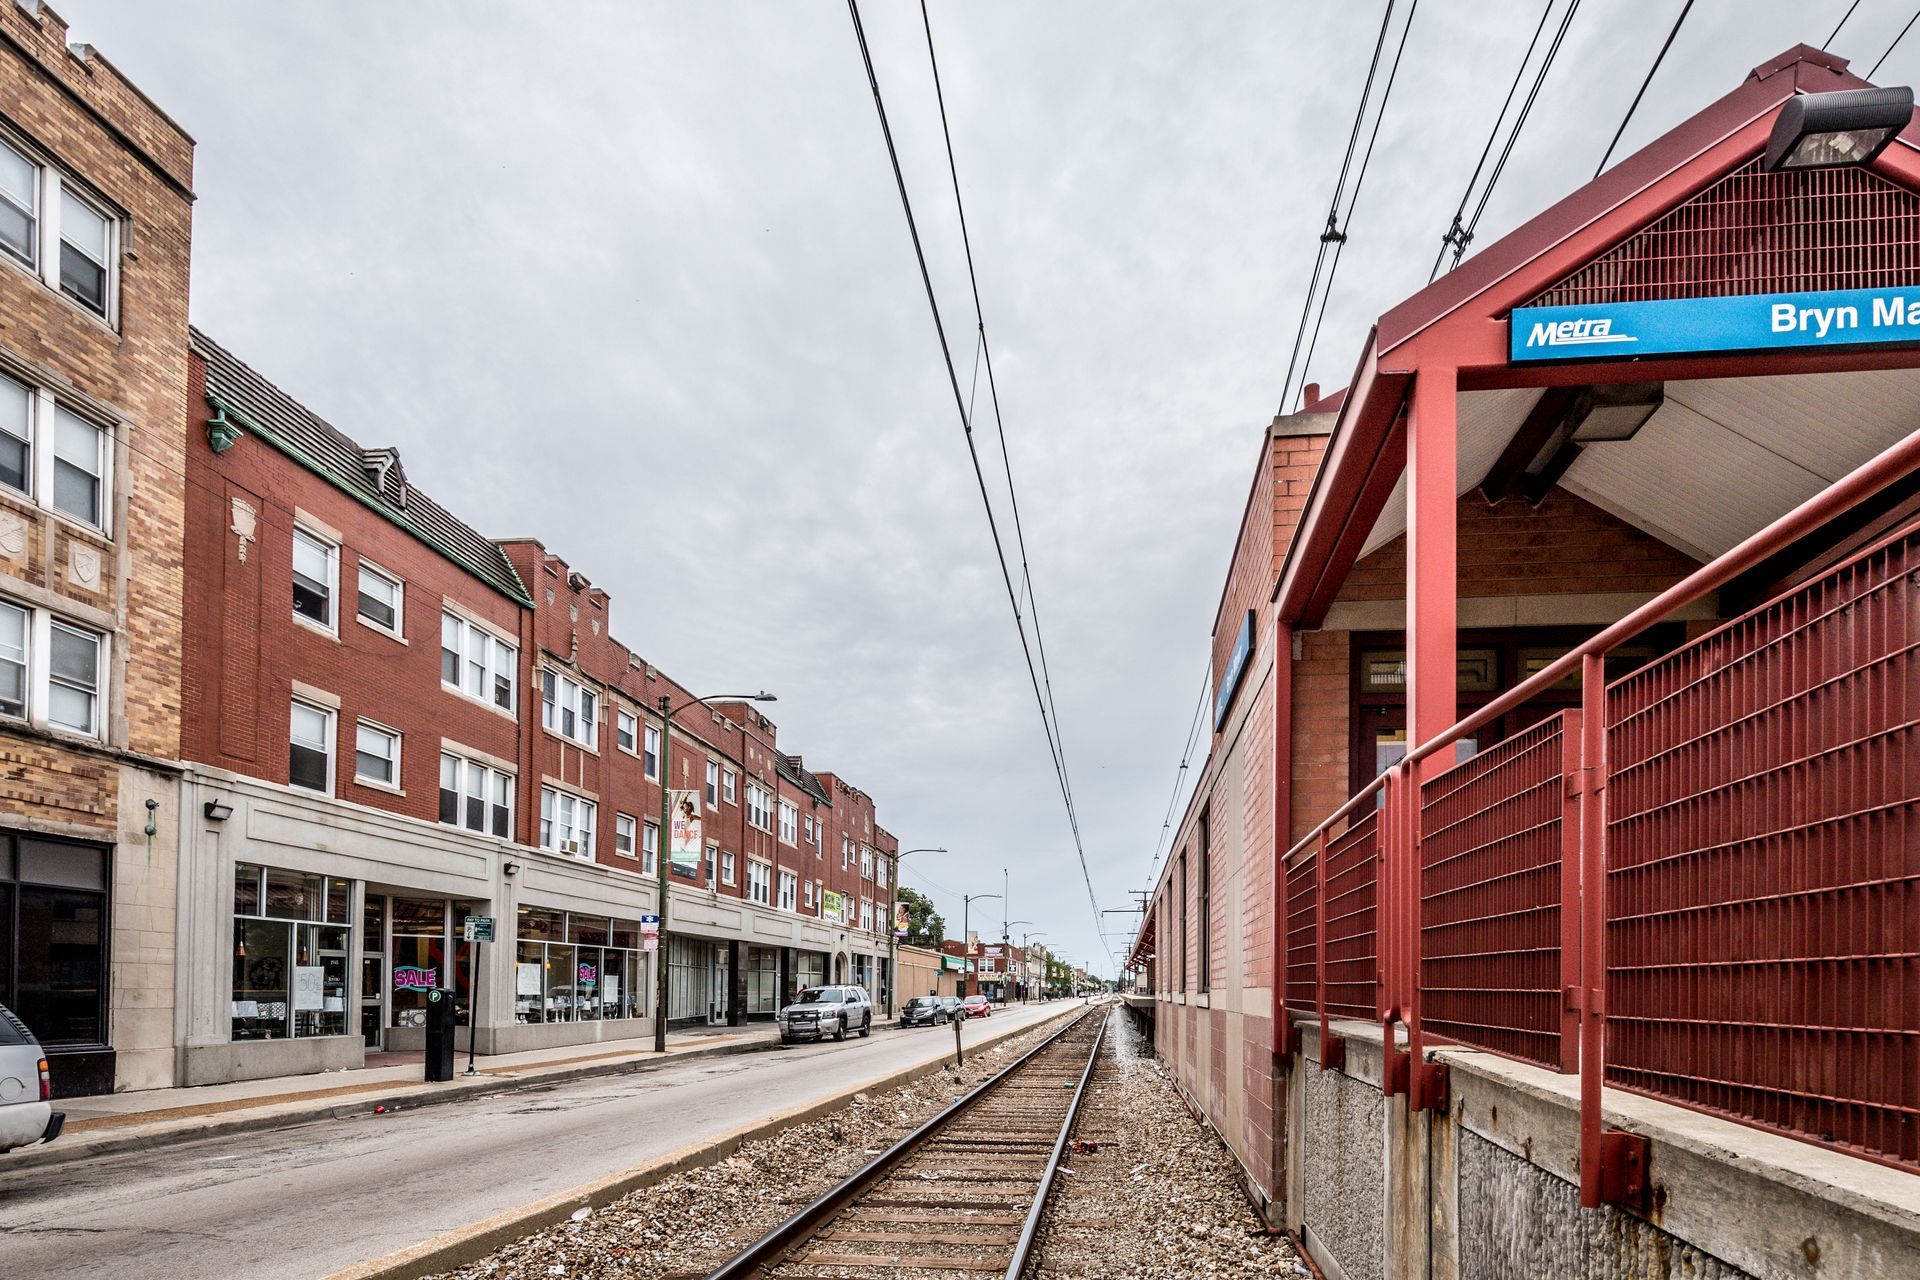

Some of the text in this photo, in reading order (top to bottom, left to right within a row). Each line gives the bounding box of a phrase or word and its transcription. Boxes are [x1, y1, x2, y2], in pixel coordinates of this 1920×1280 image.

[1526, 318, 1612, 347] Metra
[1771, 303, 1858, 338] Bryn
[673, 820, 686, 830] WE
[394, 970, 437, 987] SALE
[579, 966, 596, 982] SALE
[431, 992, 439, 1001] P
